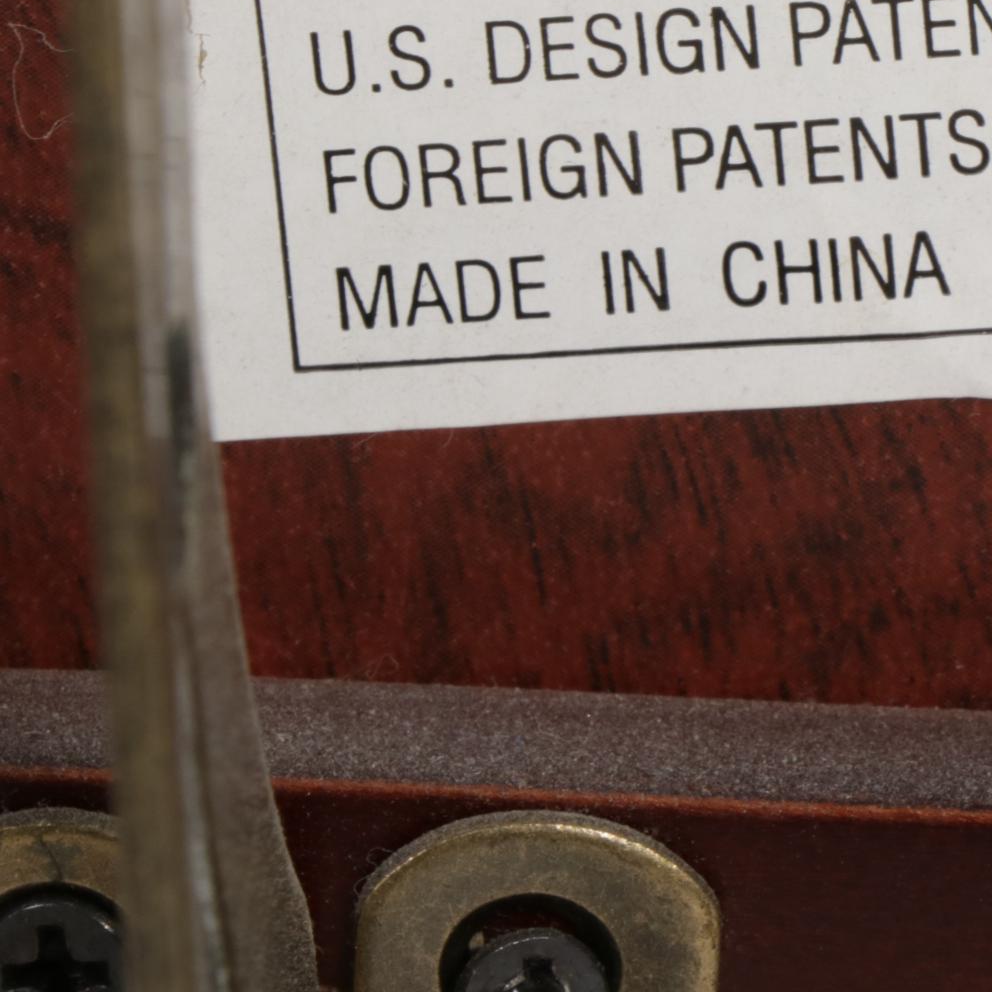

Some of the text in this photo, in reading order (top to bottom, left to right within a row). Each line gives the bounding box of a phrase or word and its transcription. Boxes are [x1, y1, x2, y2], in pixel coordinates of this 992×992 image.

[311, 25, 453, 95] U.S.
[486, 5, 759, 84] DESIGN
[324, 131, 642, 213] FOREIGN
[673, 110, 989, 192] PATENTS
[336, 231, 950, 330] MADE IN CHINA
